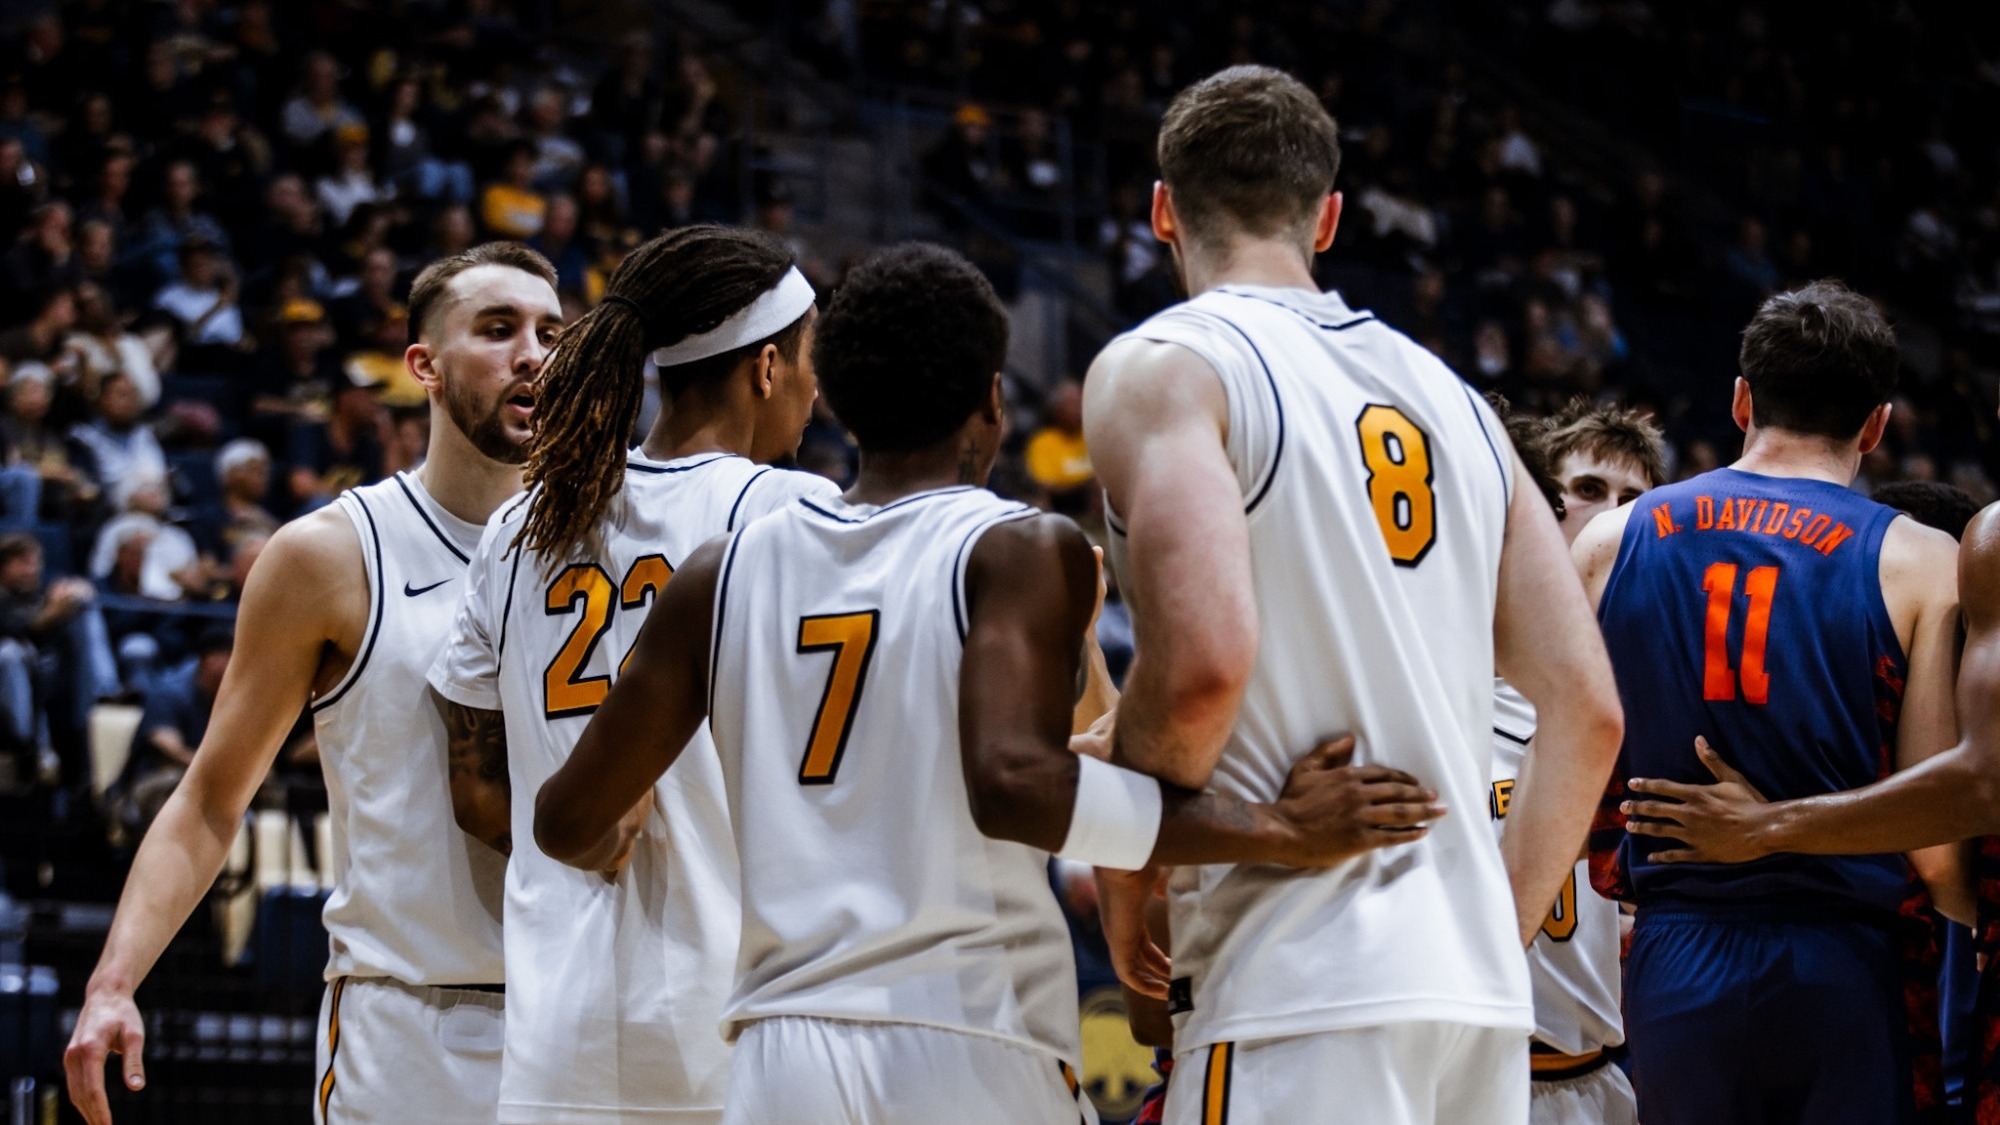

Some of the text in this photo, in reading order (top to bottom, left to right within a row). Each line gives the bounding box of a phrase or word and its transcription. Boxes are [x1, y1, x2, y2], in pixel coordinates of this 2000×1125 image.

[1355, 403, 1437, 569] 8
[1652, 496, 1854, 556] N. DAVIDSON
[796, 608, 881, 785] 7
[1702, 561, 1780, 705] 11
